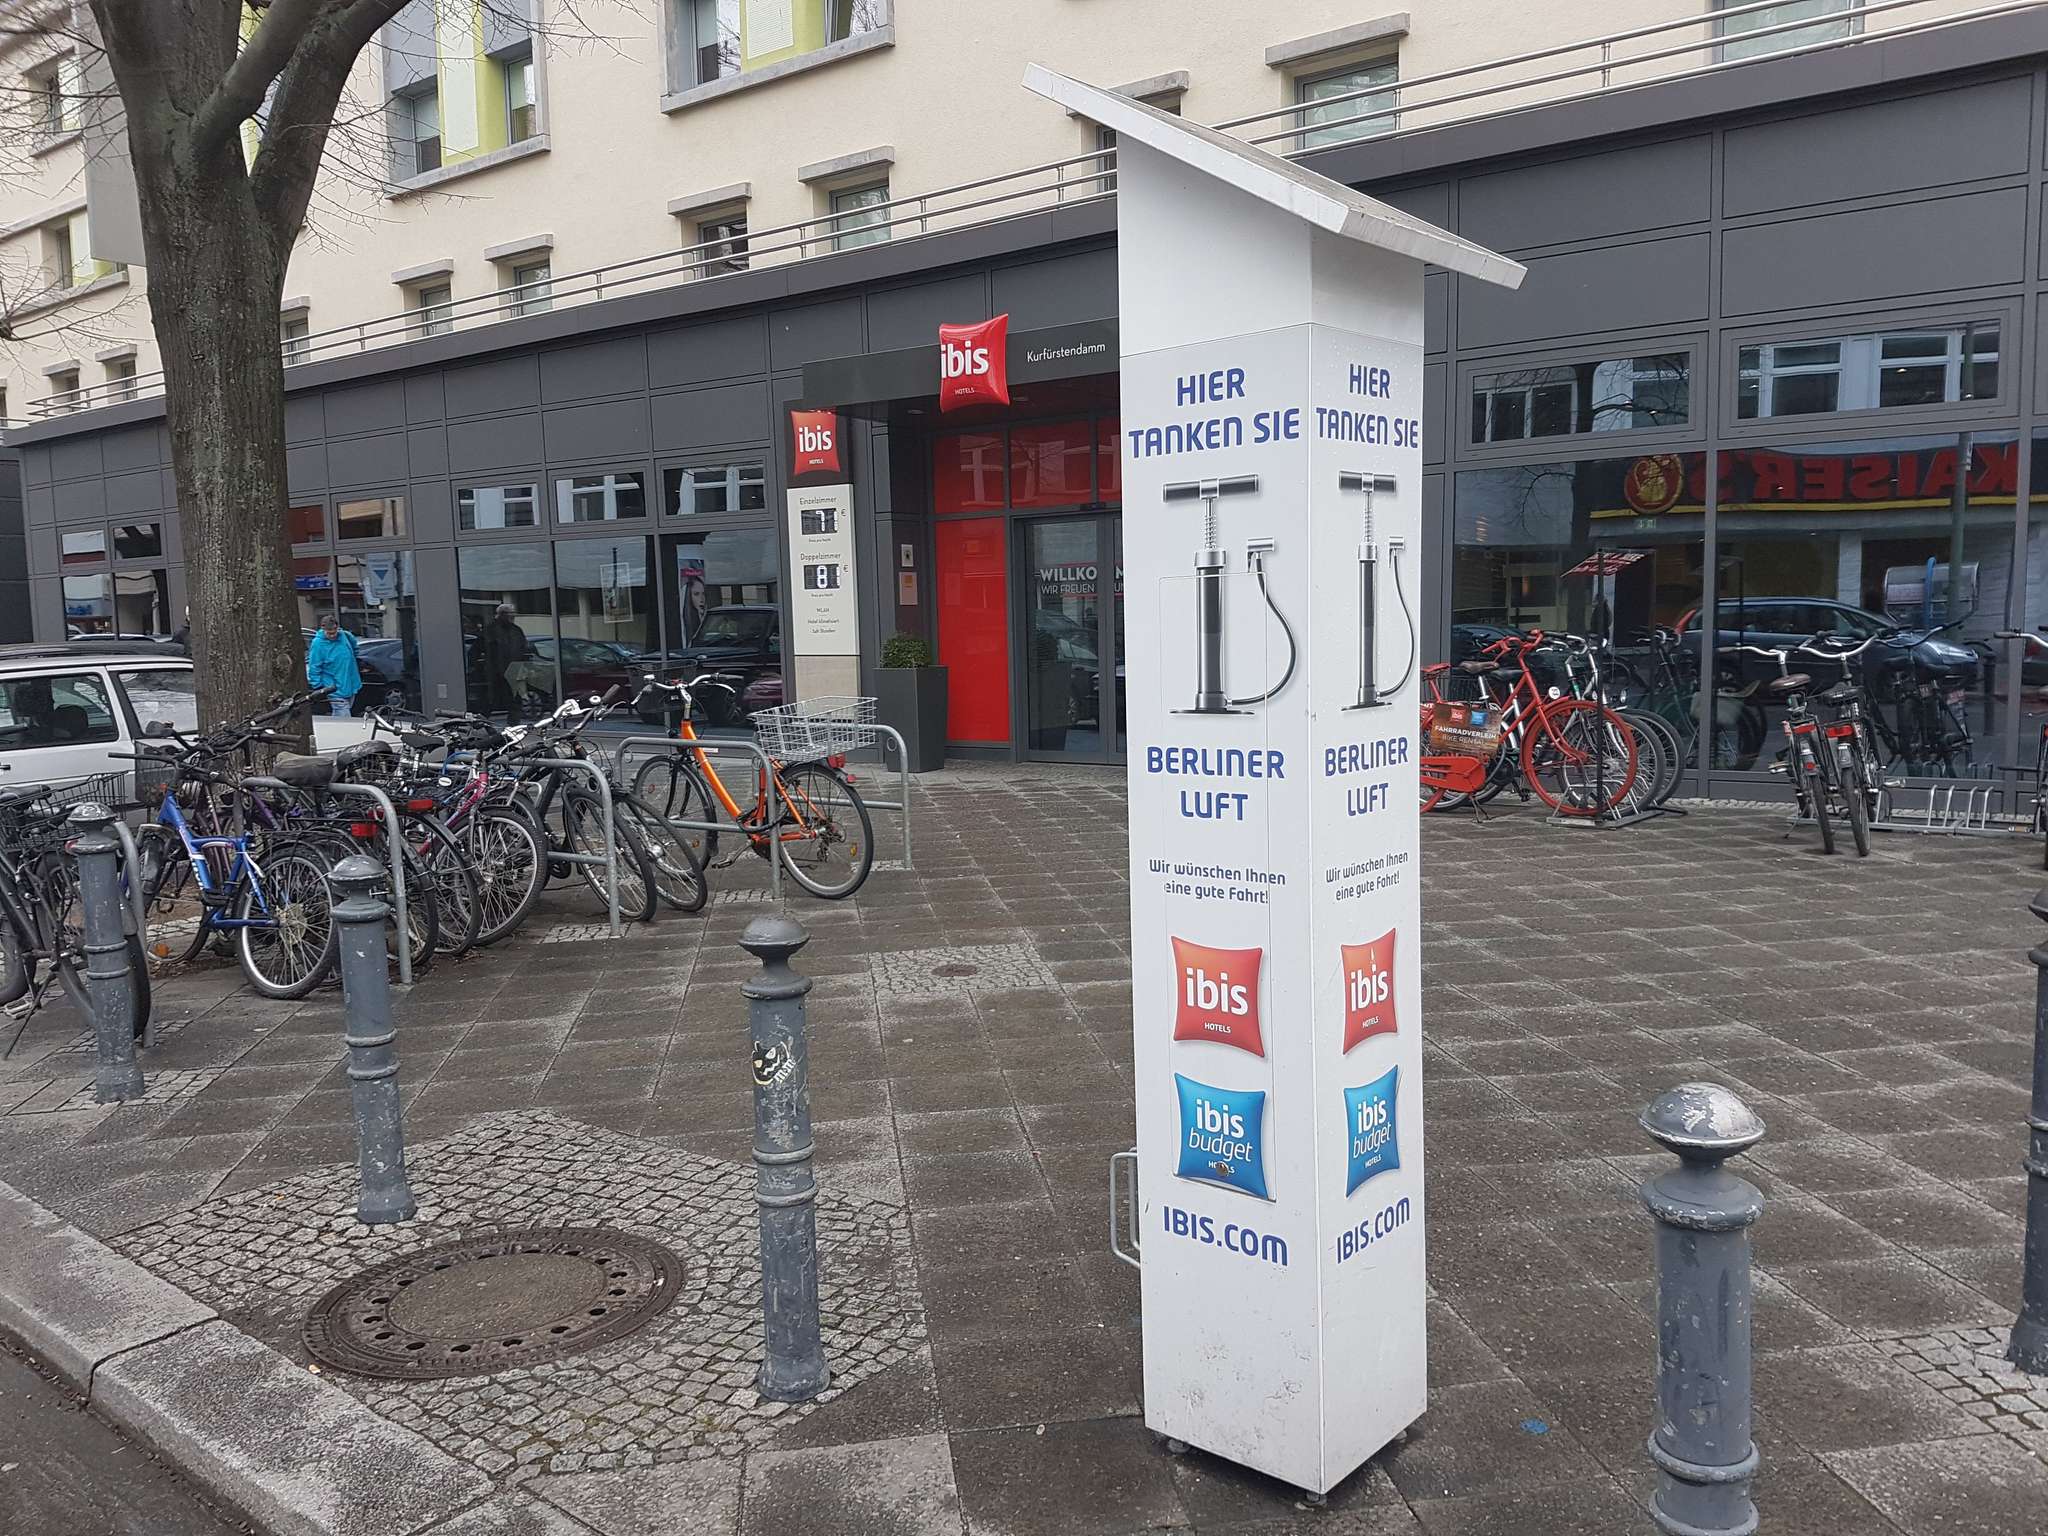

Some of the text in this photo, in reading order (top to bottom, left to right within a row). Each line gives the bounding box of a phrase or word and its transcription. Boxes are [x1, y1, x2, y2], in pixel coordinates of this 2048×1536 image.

[941, 341, 989, 378] ibis
[1027, 343, 1106, 363] Kurfürstendamm
[955, 387, 975, 396] HOTELS
[1177, 367, 1245, 407] HIER
[1349, 363, 1391, 400] HIER
[799, 424, 833, 453] ibis
[1128, 408, 1300, 458] TANKEN SIE
[1316, 407, 1419, 449] TANKEN SIE
[800, 552, 842, 562] Doppelzimmer
[816, 565, 841, 589] 81
[1041, 583, 1095, 594] WIR FREUEN
[1434, 725, 1497, 739] FAHRRADVERLEIH
[1147, 746, 1285, 779] BERLINER
[1325, 737, 1409, 777] BERLINER
[1180, 791, 1249, 821] LUFT
[1346, 783, 1389, 817] LUFT
[1149, 859, 1286, 886] Wir wünschen Ihnen
[1326, 852, 1409, 883] Wir wünschen Ihnen
[1164, 880, 1269, 904] eine gute Fahrt!
[1335, 870, 1400, 901] eine gute Fahrt!
[1187, 967, 1249, 1016] ibis
[1350, 963, 1389, 1013] ibis
[1204, 1022, 1231, 1034] HOTELS
[1196, 1098, 1245, 1138] ibis
[1357, 1095, 1388, 1135] ibis
[1188, 1127, 1253, 1162] budget
[1353, 1121, 1392, 1159] budget
[1163, 1206, 1288, 1266] IBIS.COM
[1336, 1197, 1410, 1265] IBIS.COM
